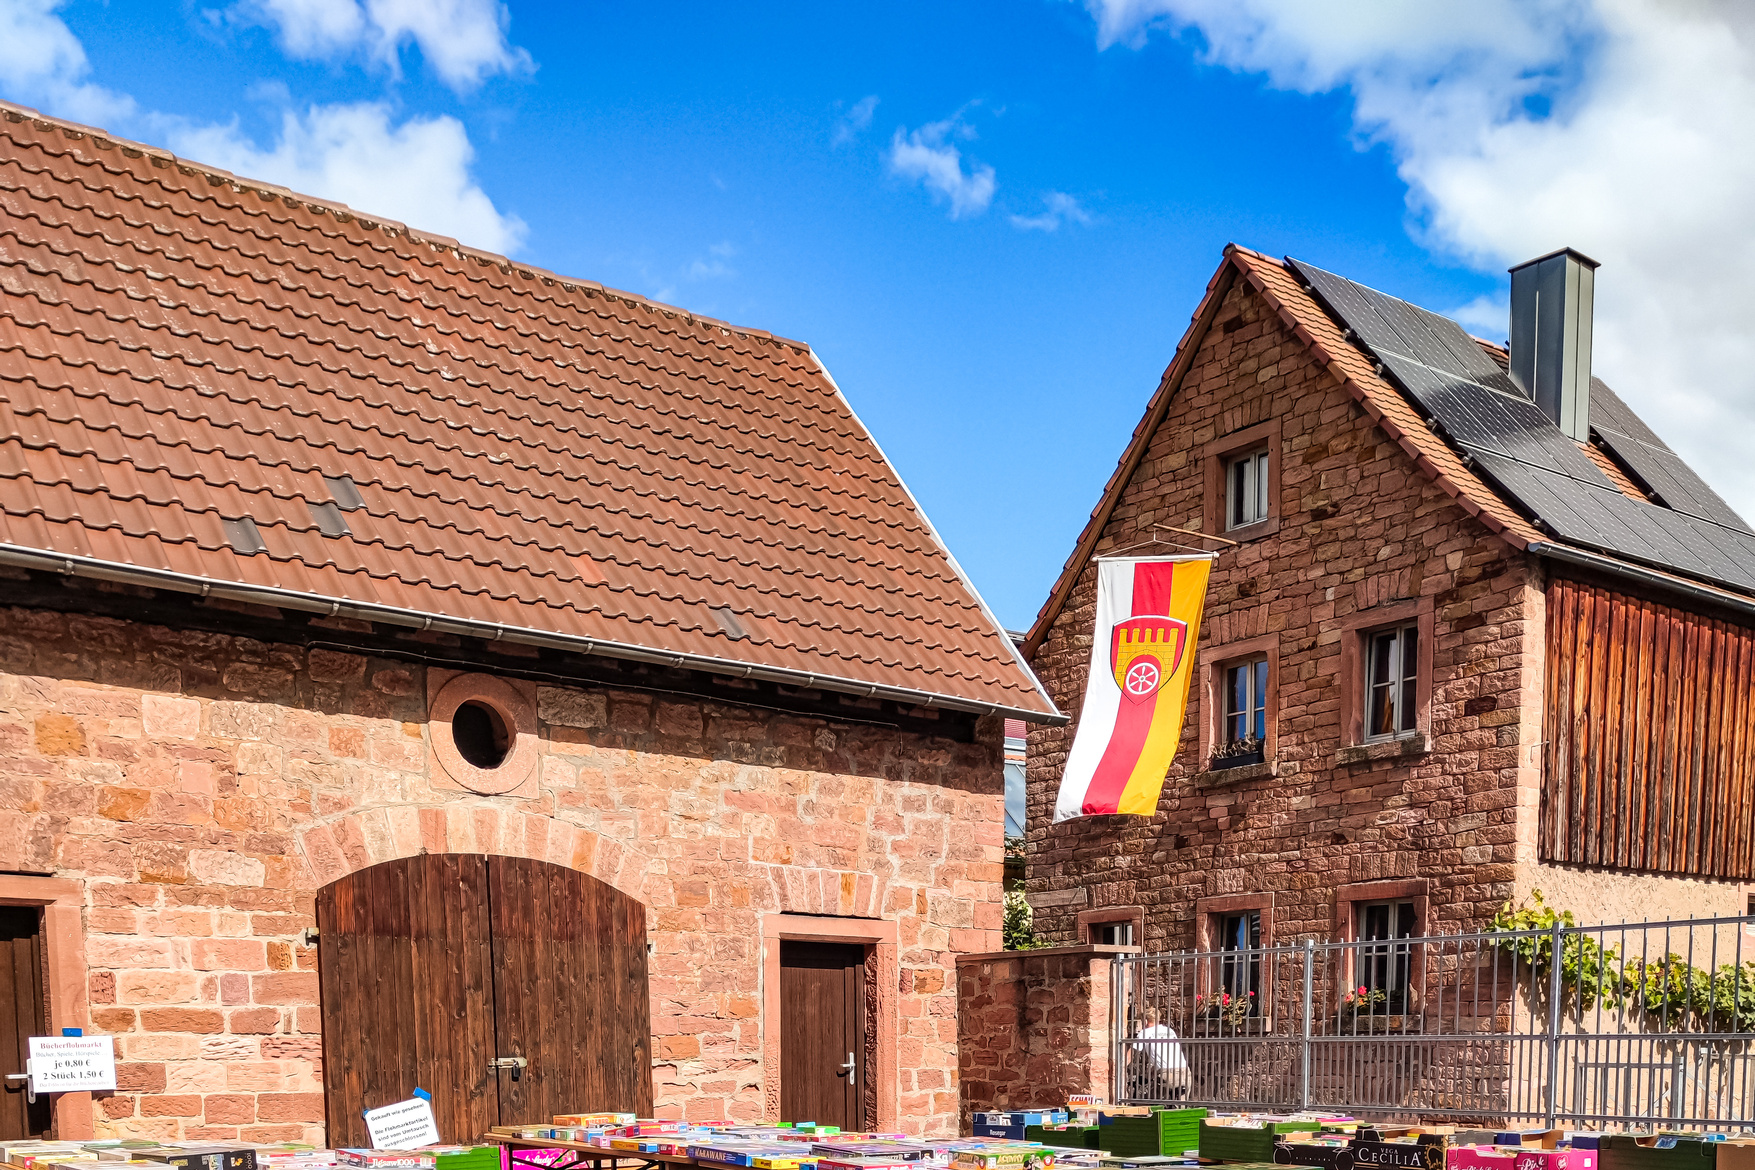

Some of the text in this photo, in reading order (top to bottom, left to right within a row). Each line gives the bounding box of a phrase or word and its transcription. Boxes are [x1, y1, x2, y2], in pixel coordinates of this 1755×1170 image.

[40, 1041, 102, 1050] Bücherflohmarkt
[54, 1059, 91, 1069] je 0,80 €
[43, 1069, 105, 1080] 2 Stück 1,50 €
[371, 1112, 391, 1122] Gekauft
[401, 1103, 424, 1114] gesehen!
[401, 1124, 429, 1135] Umtausch
